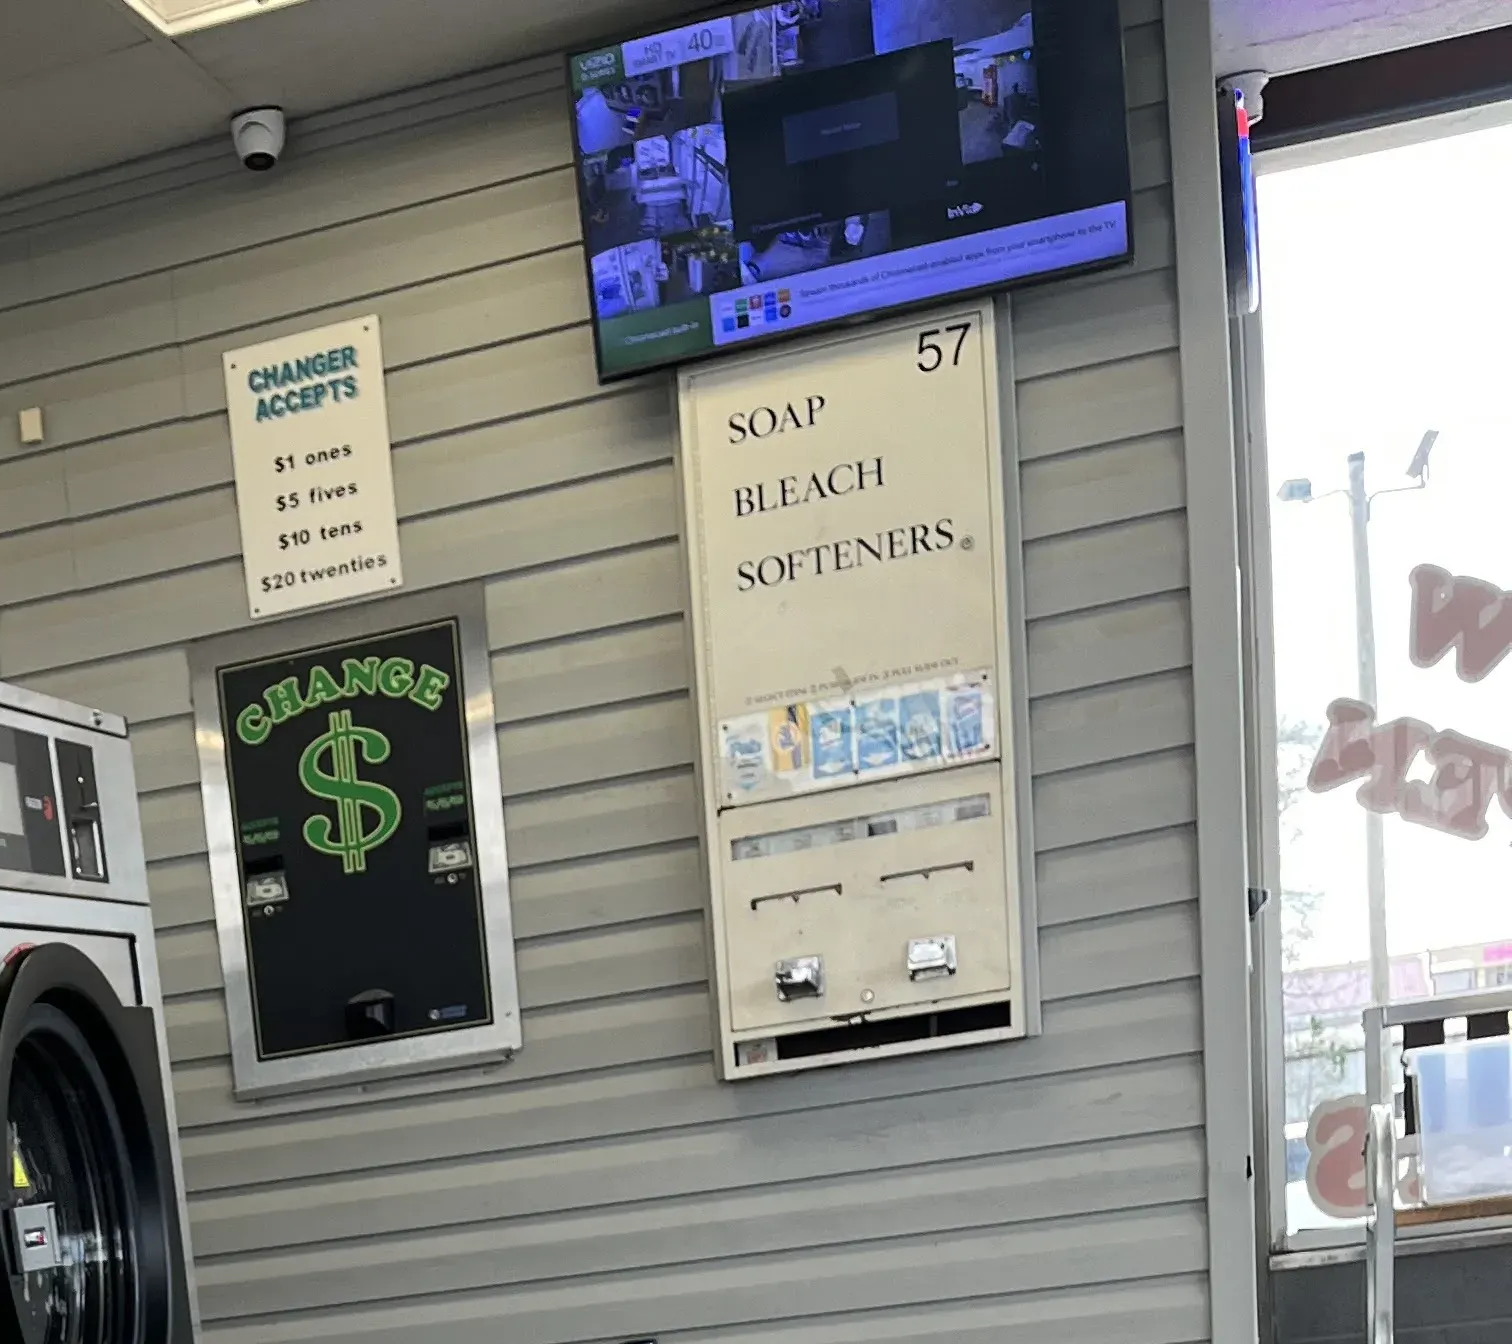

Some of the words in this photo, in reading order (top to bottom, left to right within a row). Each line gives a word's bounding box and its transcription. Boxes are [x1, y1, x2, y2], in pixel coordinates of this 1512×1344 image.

[688, 28, 713, 53] 40
[247, 344, 359, 394] CHANGER
[916, 322, 972, 372] 57
[255, 375, 359, 422] ACCEPTS
[728, 394, 826, 445] SOAP
[274, 455, 296, 474] $1
[305, 443, 353, 467] ones
[276, 493, 300, 512] $5
[310, 480, 358, 504] fives
[733, 455, 885, 518] BLEACH
[278, 529, 311, 550] $10
[320, 520, 364, 540] tens
[737, 518, 955, 593] SOFTENERS
[261, 570, 296, 593] $20
[300, 553, 388, 584] twenties
[236, 656, 450, 745] CHANGE
